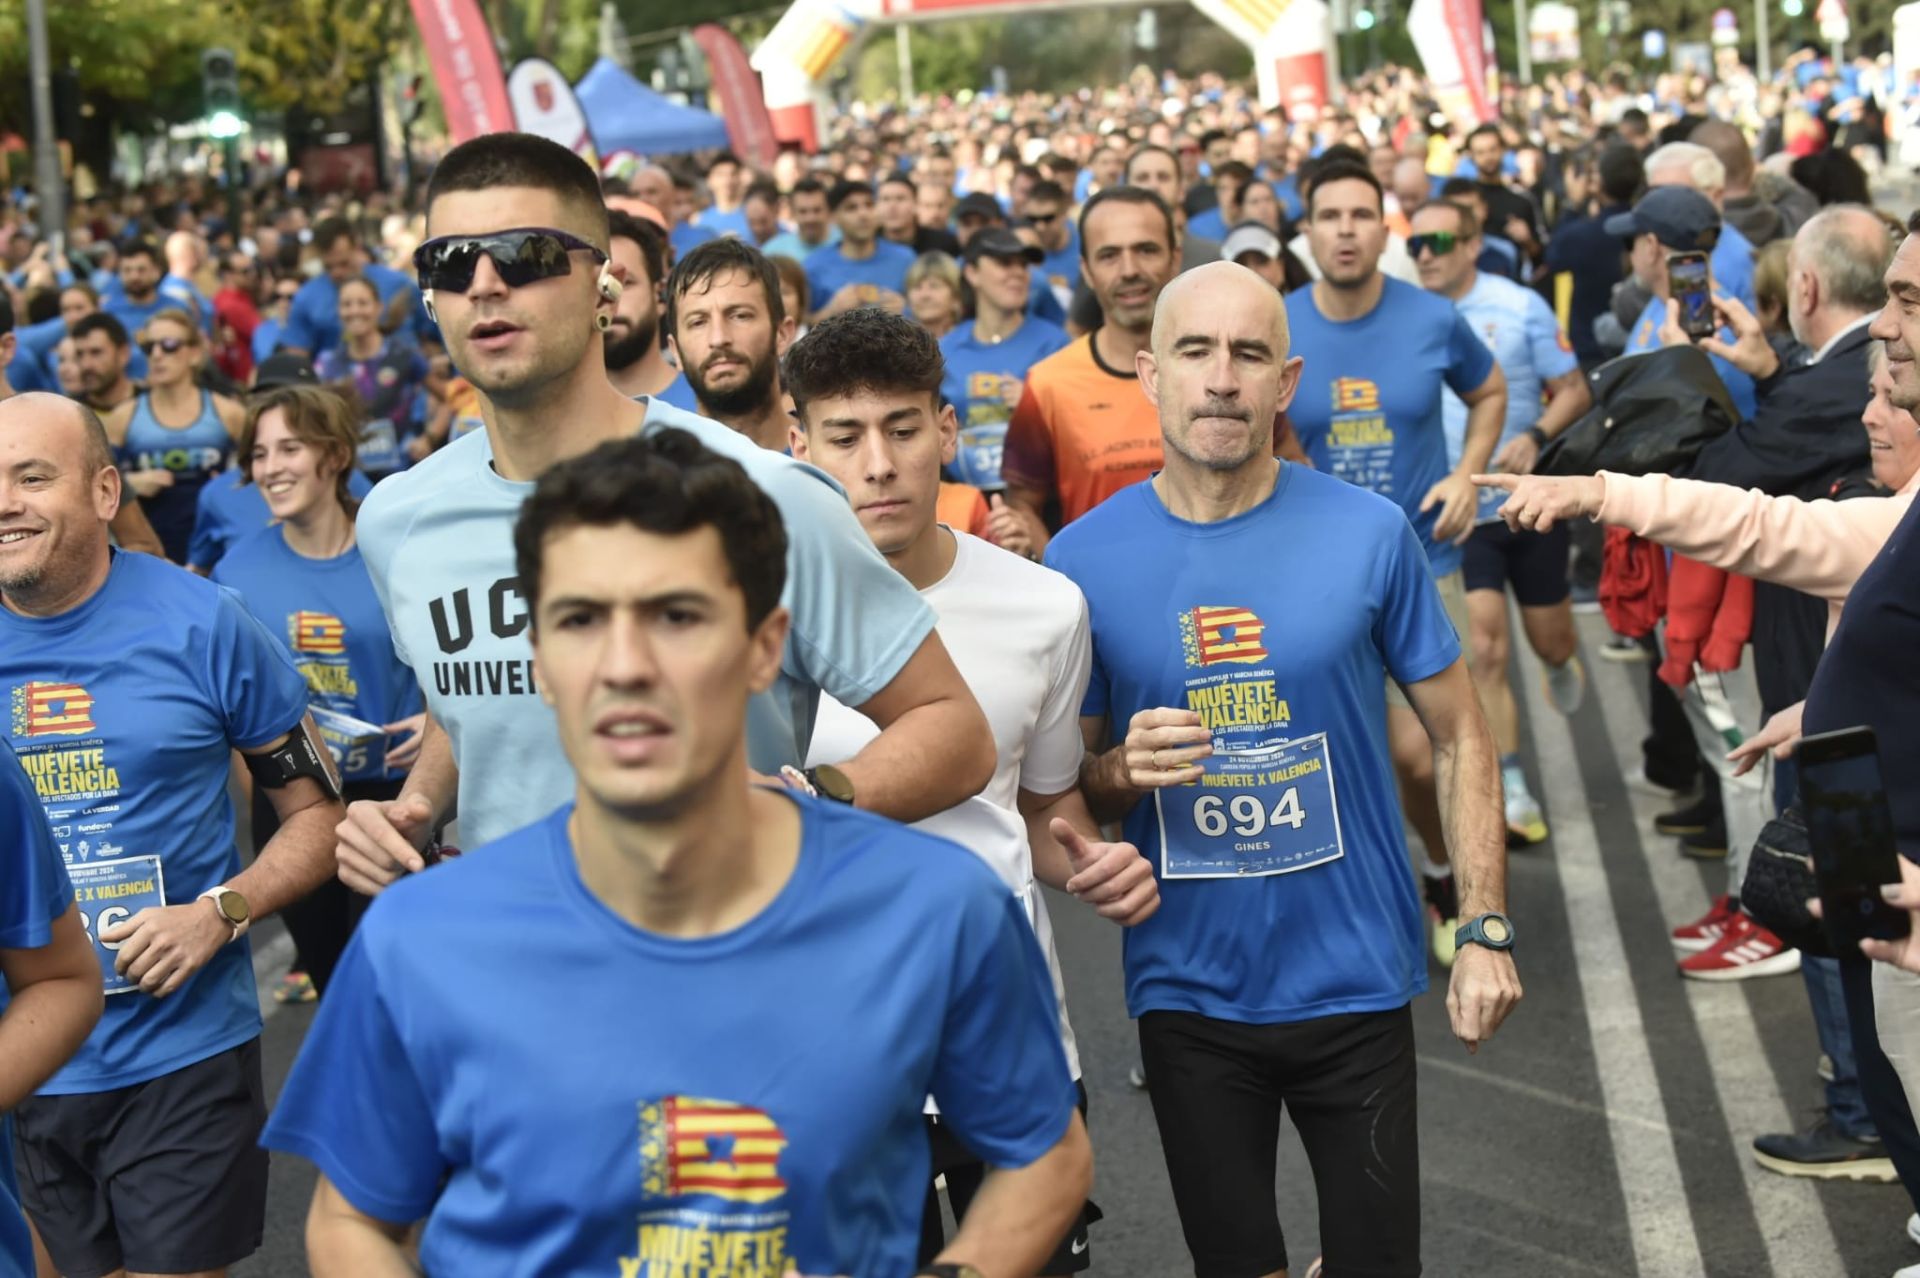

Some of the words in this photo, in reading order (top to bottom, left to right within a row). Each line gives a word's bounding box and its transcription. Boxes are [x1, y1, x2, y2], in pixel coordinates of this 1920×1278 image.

[1187, 680, 1277, 710] MUÉVETE
[1199, 700, 1291, 730] VALENCIA
[33, 767, 120, 797] ALENCIA
[1202, 772, 1255, 787] MUÉVETE
[1257, 773, 1267, 786] X
[1268, 757, 1322, 785] VALENCIA
[1193, 786, 1306, 838] 694
[1234, 841, 1271, 852] GINES
[86, 887, 94, 901] X
[96, 879, 154, 900] VALENCIA
[638, 1222, 788, 1269] MUÉVETE
